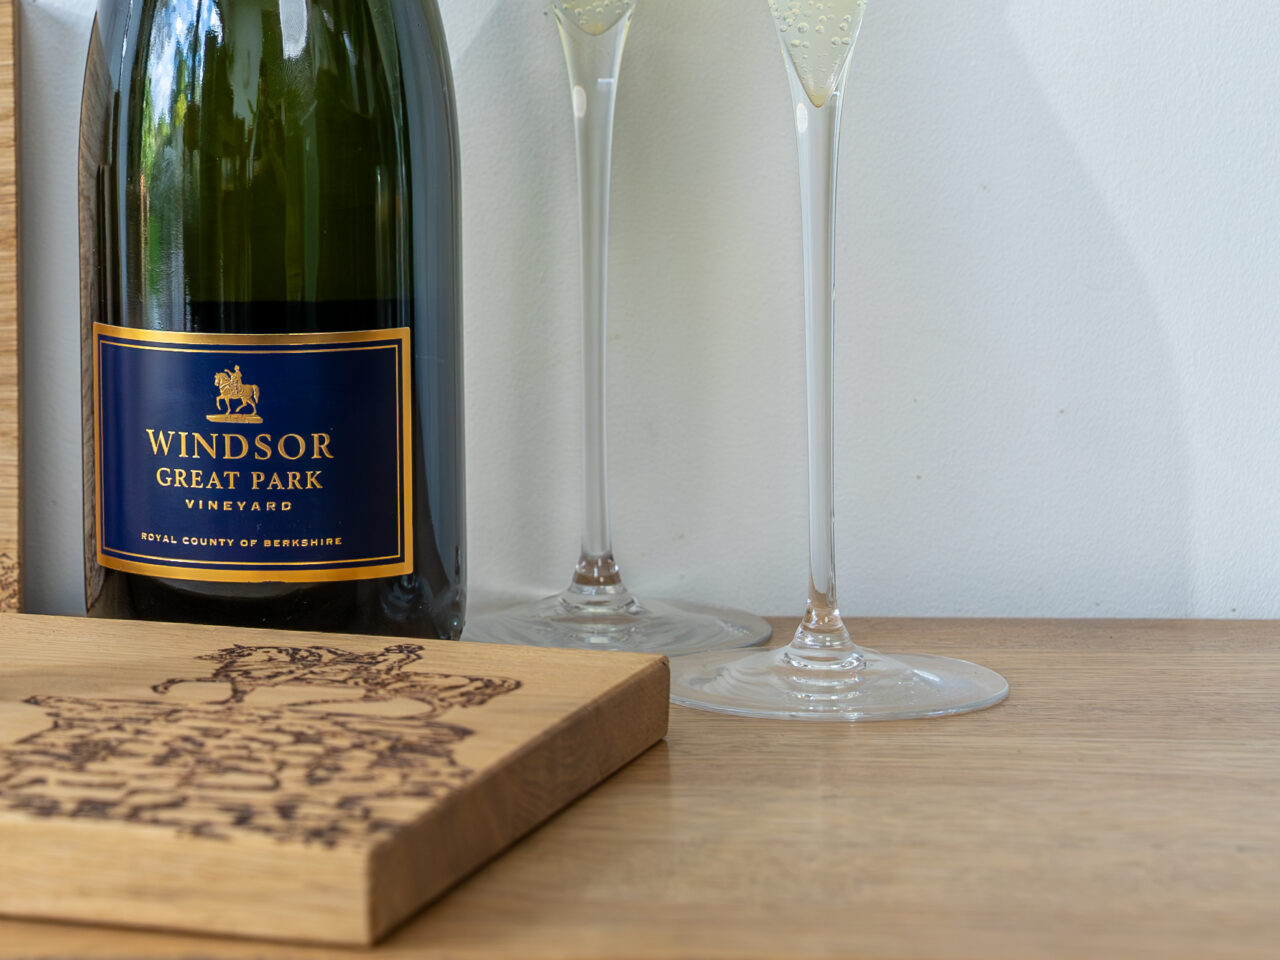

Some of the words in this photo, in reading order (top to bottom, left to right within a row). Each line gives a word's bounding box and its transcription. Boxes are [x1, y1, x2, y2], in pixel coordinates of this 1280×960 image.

[145, 428, 335, 460] WINDSOR
[156, 467, 240, 490] GREAT
[251, 470, 323, 490] PARK
[185, 499, 292, 511] VINEYARD
[141, 532, 178, 545] ROYAL
[182, 536, 235, 547] COUNTY
[240, 539, 258, 547] OF
[263, 537, 343, 547] BERKSHIRE
